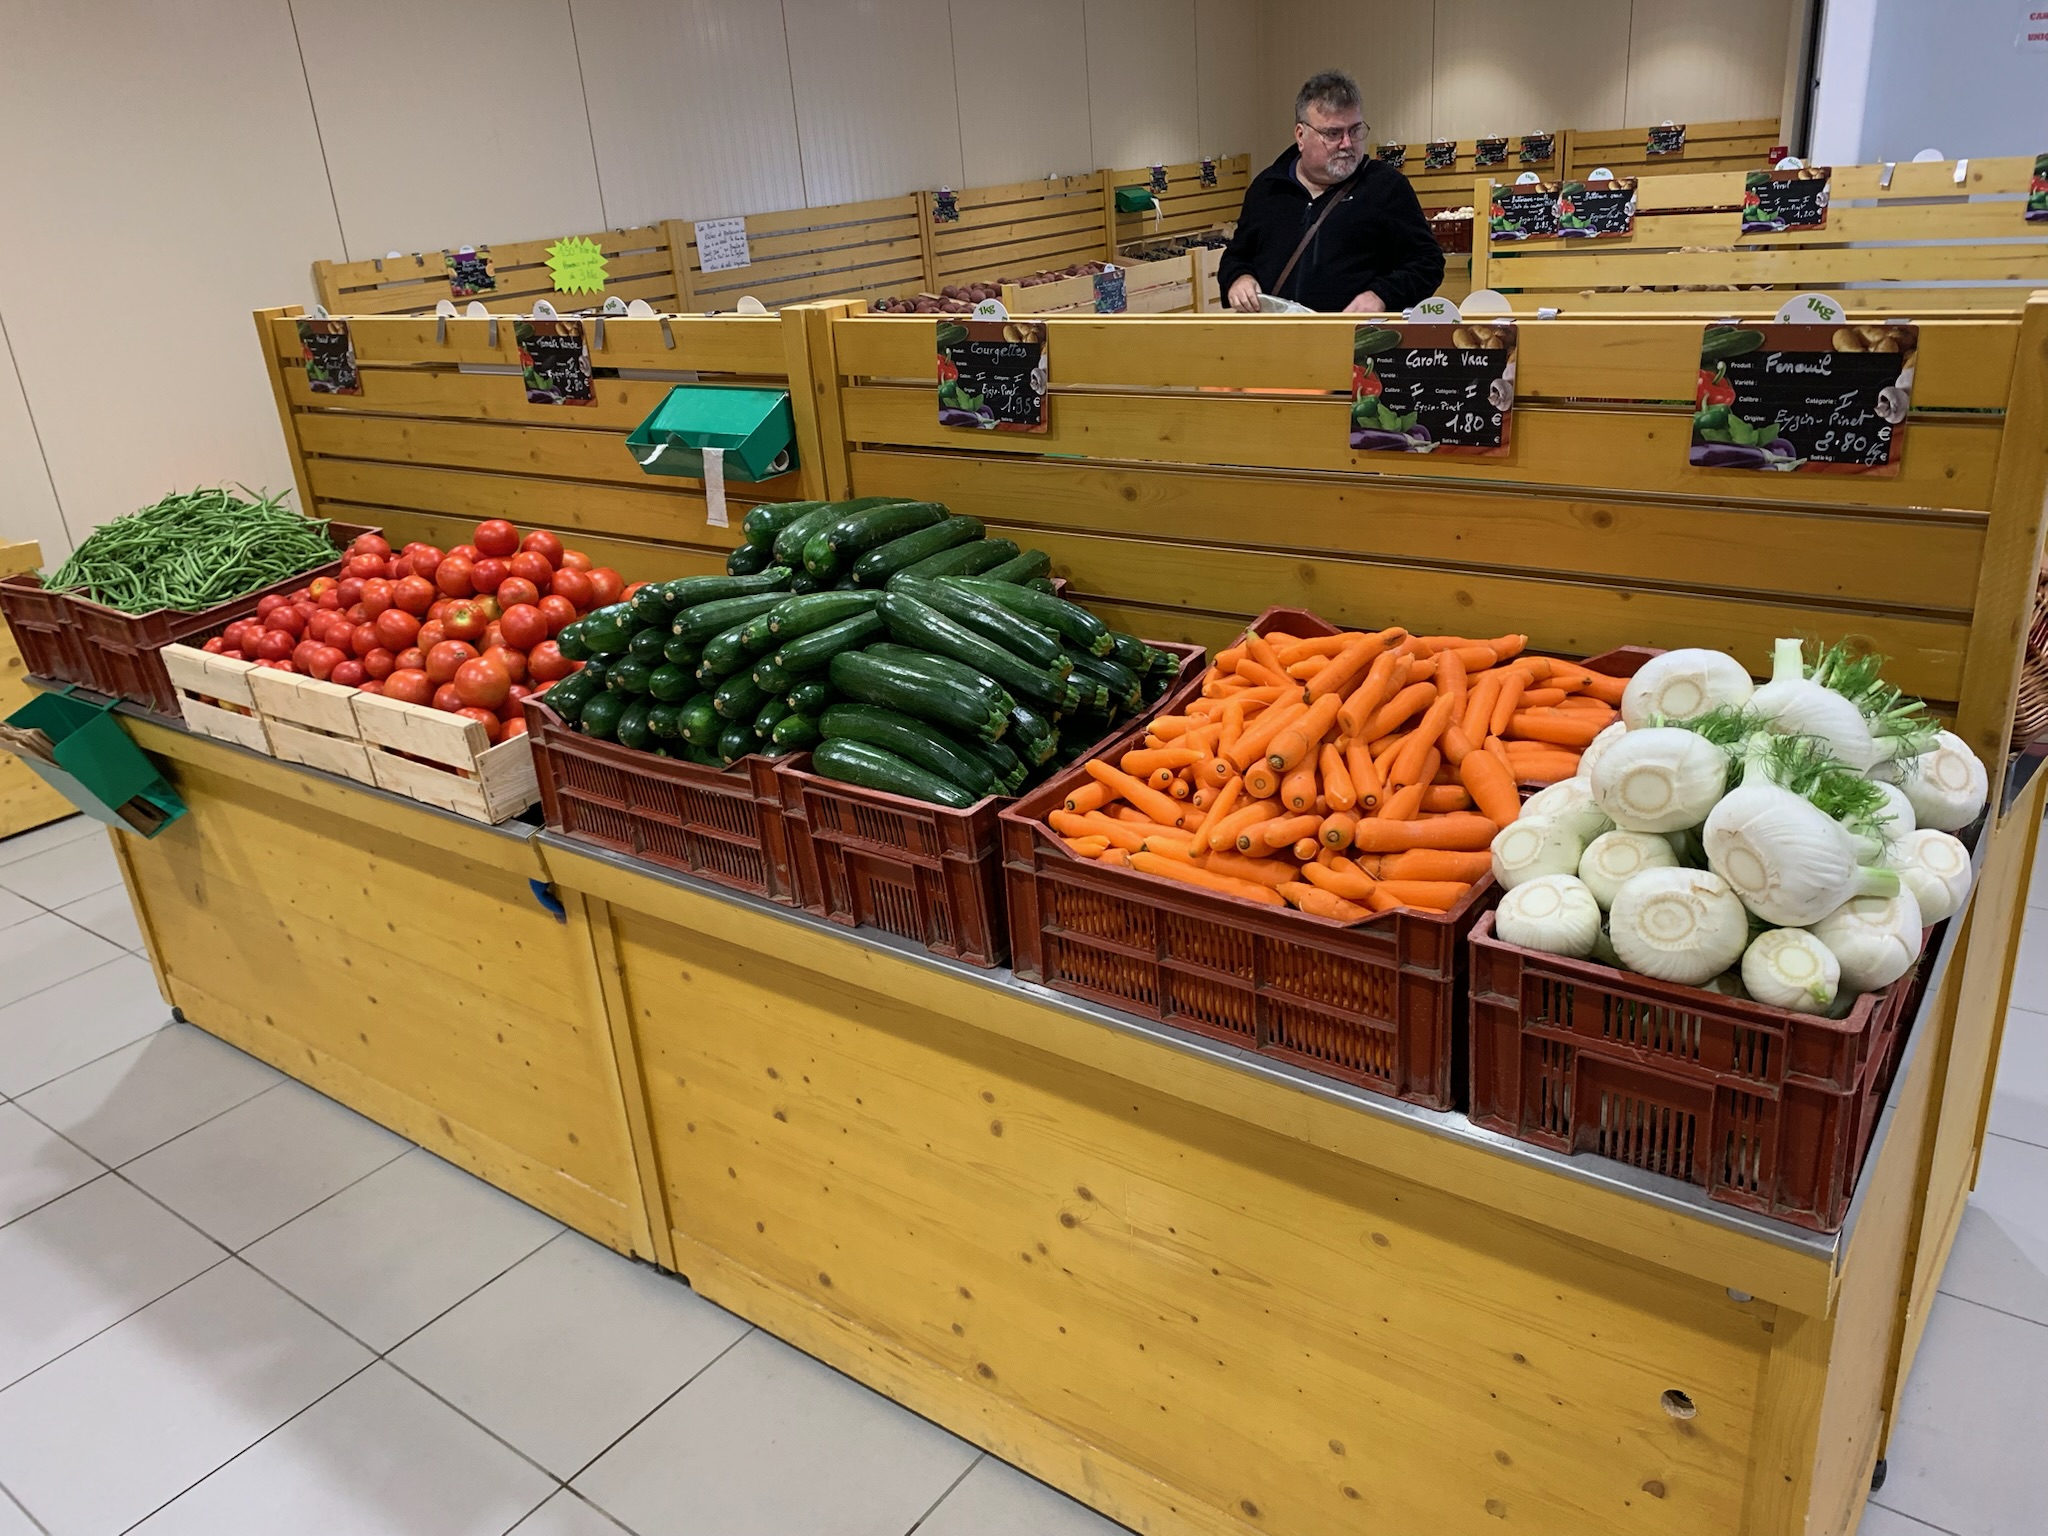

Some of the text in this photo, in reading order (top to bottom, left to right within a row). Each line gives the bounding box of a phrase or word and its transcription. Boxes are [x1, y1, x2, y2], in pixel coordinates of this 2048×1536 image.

[978, 304, 996, 315] 1kg
[1420, 303, 1445, 315] 1kg
[1807, 297, 1836, 321] 1kg
[970, 342, 1027, 365] Courgettes
[1405, 349, 1449, 368] Carotte
[1410, 382, 1424, 397] I
[1464, 384, 1478, 399] I
